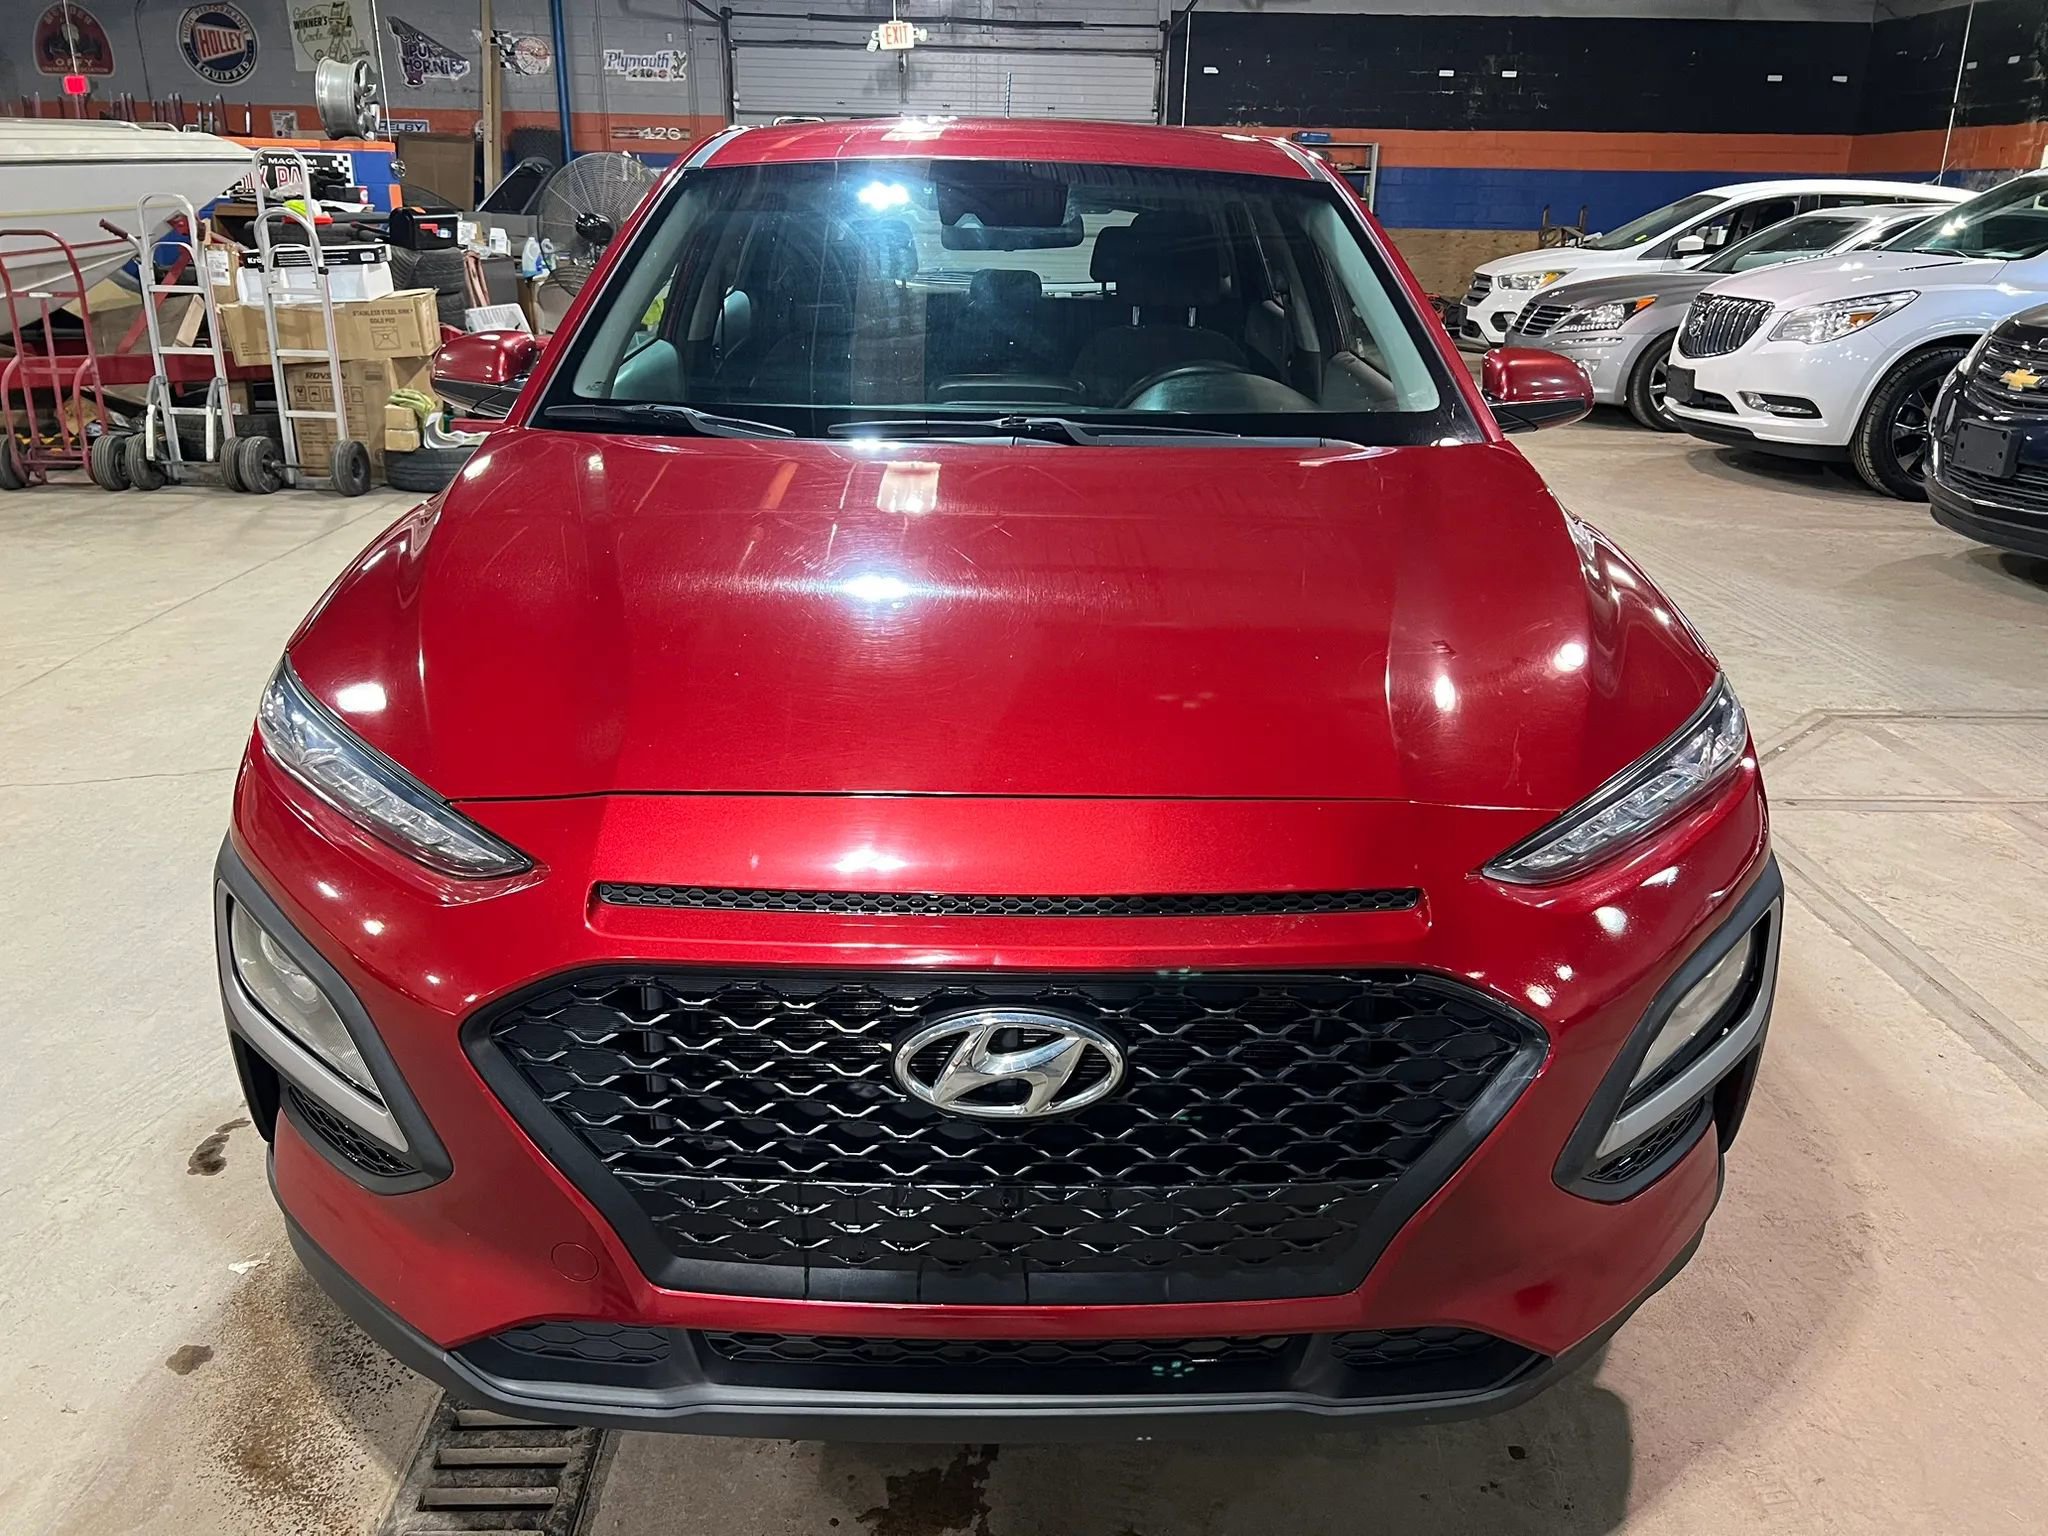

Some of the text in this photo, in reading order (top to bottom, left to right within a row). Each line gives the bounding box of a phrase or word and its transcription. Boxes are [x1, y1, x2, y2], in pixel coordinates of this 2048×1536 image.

[198, 28, 243, 59] HOLLEY
[885, 25, 908, 45] EXIT
[605, 51, 670, 72] Plymouth
[642, 127, 682, 141] 426
